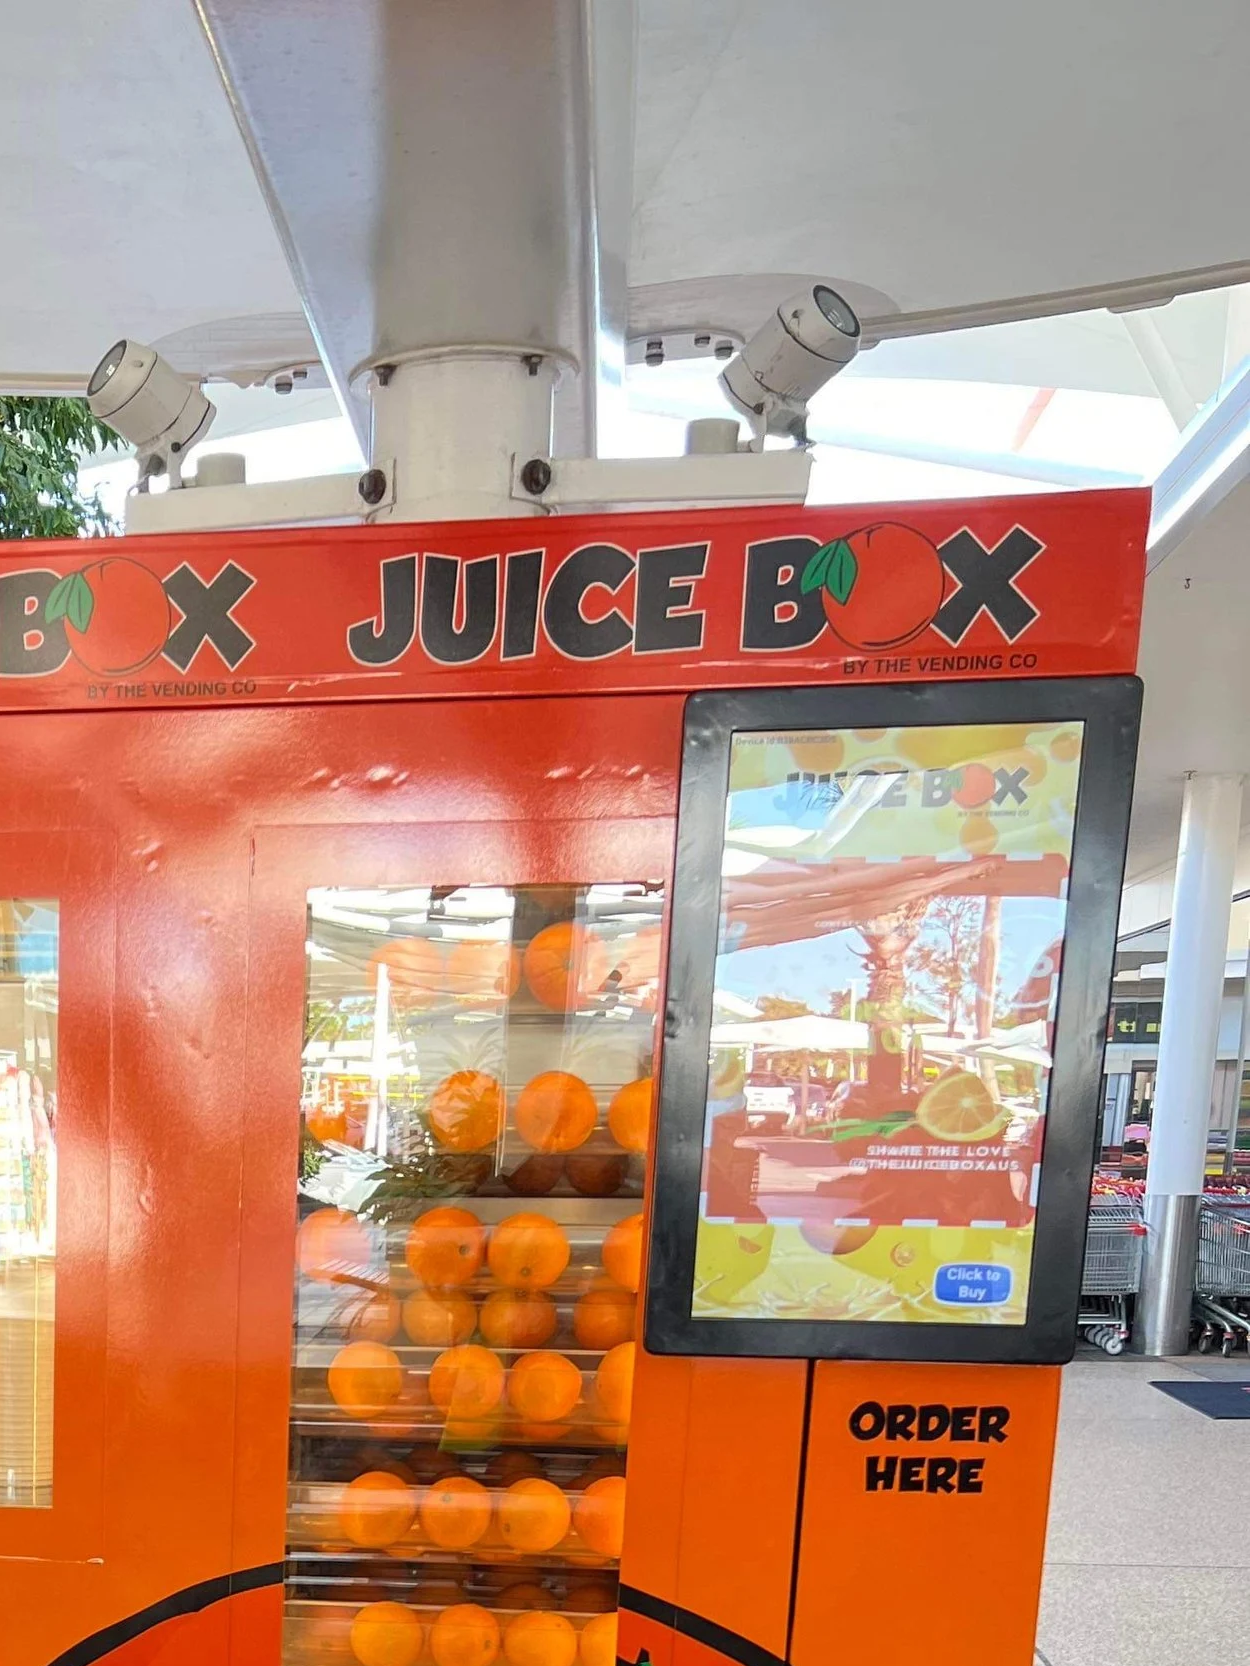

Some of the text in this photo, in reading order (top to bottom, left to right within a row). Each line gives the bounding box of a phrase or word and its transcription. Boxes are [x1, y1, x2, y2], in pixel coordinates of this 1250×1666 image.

[347, 541, 711, 669] JUICE
[843, 653, 1038, 675] BY THE VENDING CO
[87, 679, 258, 700] BY THE VENDING CO
[966, 1146, 1012, 1158] LOVE
[947, 1267, 1002, 1282] Click to
[958, 1285, 987, 1301] Buy
[848, 1400, 1011, 1444] ORDER
[865, 1456, 986, 1495] HERE
